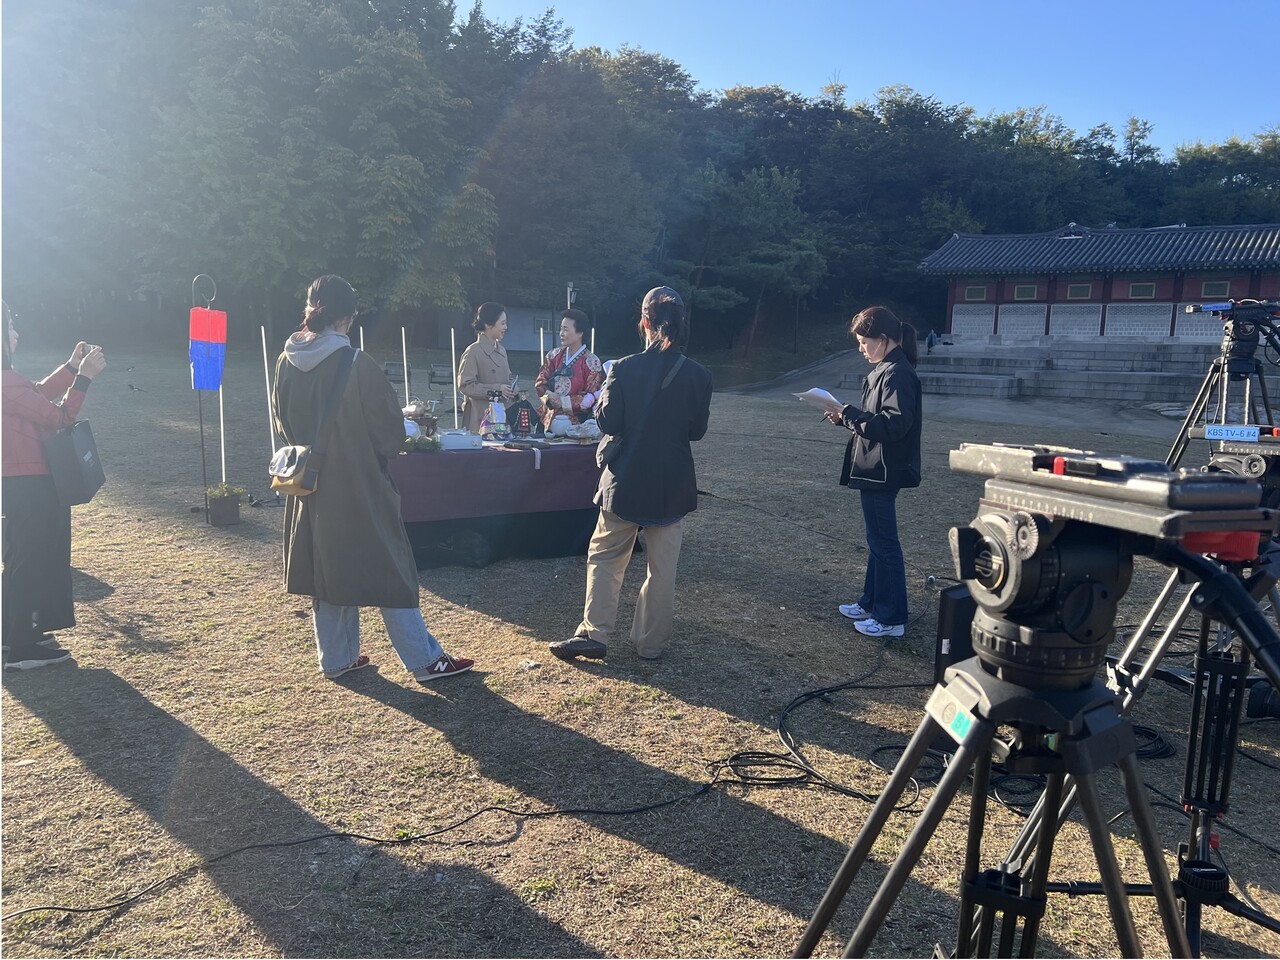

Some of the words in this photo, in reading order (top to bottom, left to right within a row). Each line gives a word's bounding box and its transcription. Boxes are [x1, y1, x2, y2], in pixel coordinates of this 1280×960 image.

[1207, 428, 1223, 437] KBS
[1225, 429, 1245, 438] TV-6
[434, 661, 448, 672] N
